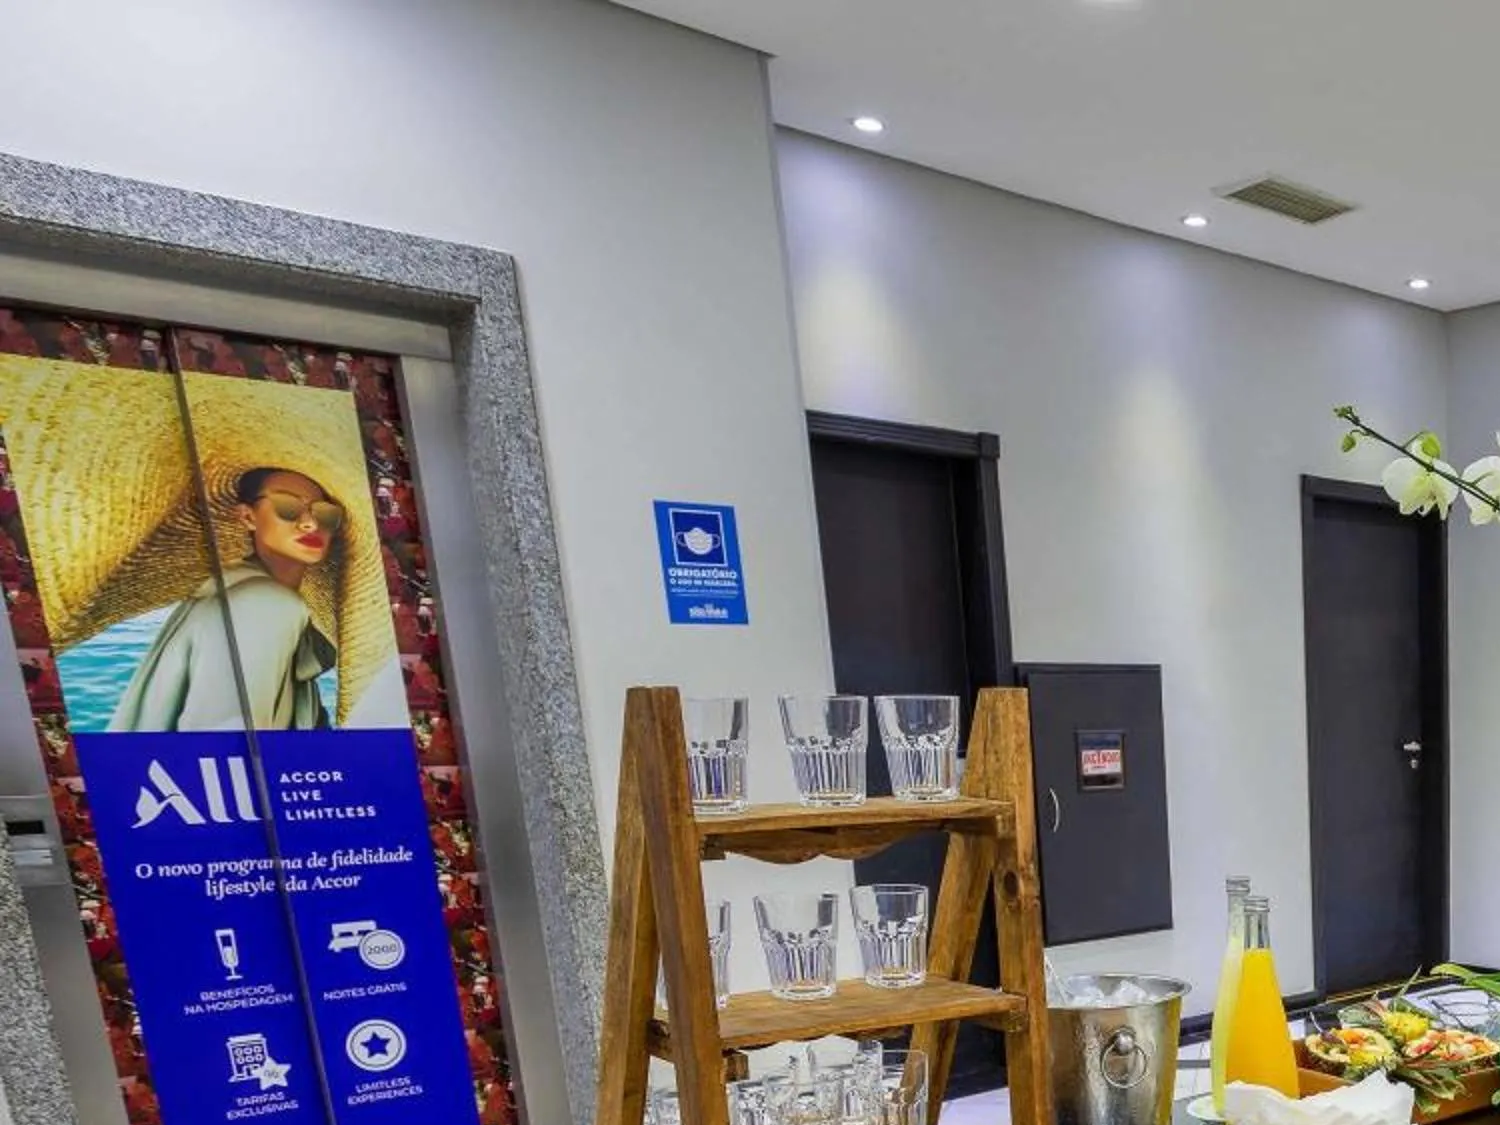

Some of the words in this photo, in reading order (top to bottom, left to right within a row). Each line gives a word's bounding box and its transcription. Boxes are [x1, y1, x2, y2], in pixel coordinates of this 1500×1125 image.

[279, 771, 344, 783] ACCOR
[281, 789, 323, 803] LIVE
[285, 805, 377, 821] LIMITLESS
[135, 863, 153, 879] O
[157, 863, 203, 877] novo
[206, 857, 303, 879] programa
[306, 851, 328, 869] de
[328, 845, 414, 872] fidelidade
[205, 875, 277, 901] lifestyle
[284, 874, 308, 893] da
[311, 874, 363, 892] Accor
[323, 987, 367, 1001] NOITES
[184, 1003, 205, 1015] NA
[205, 993, 295, 1013] HOSPEDAGEM
[355, 1076, 412, 1094] LIMITLESS
[236, 1091, 286, 1106] TARIFAS
[347, 1085, 424, 1105] EXPERIENCES
[226, 1099, 300, 1120] EXCLUSIVAS
